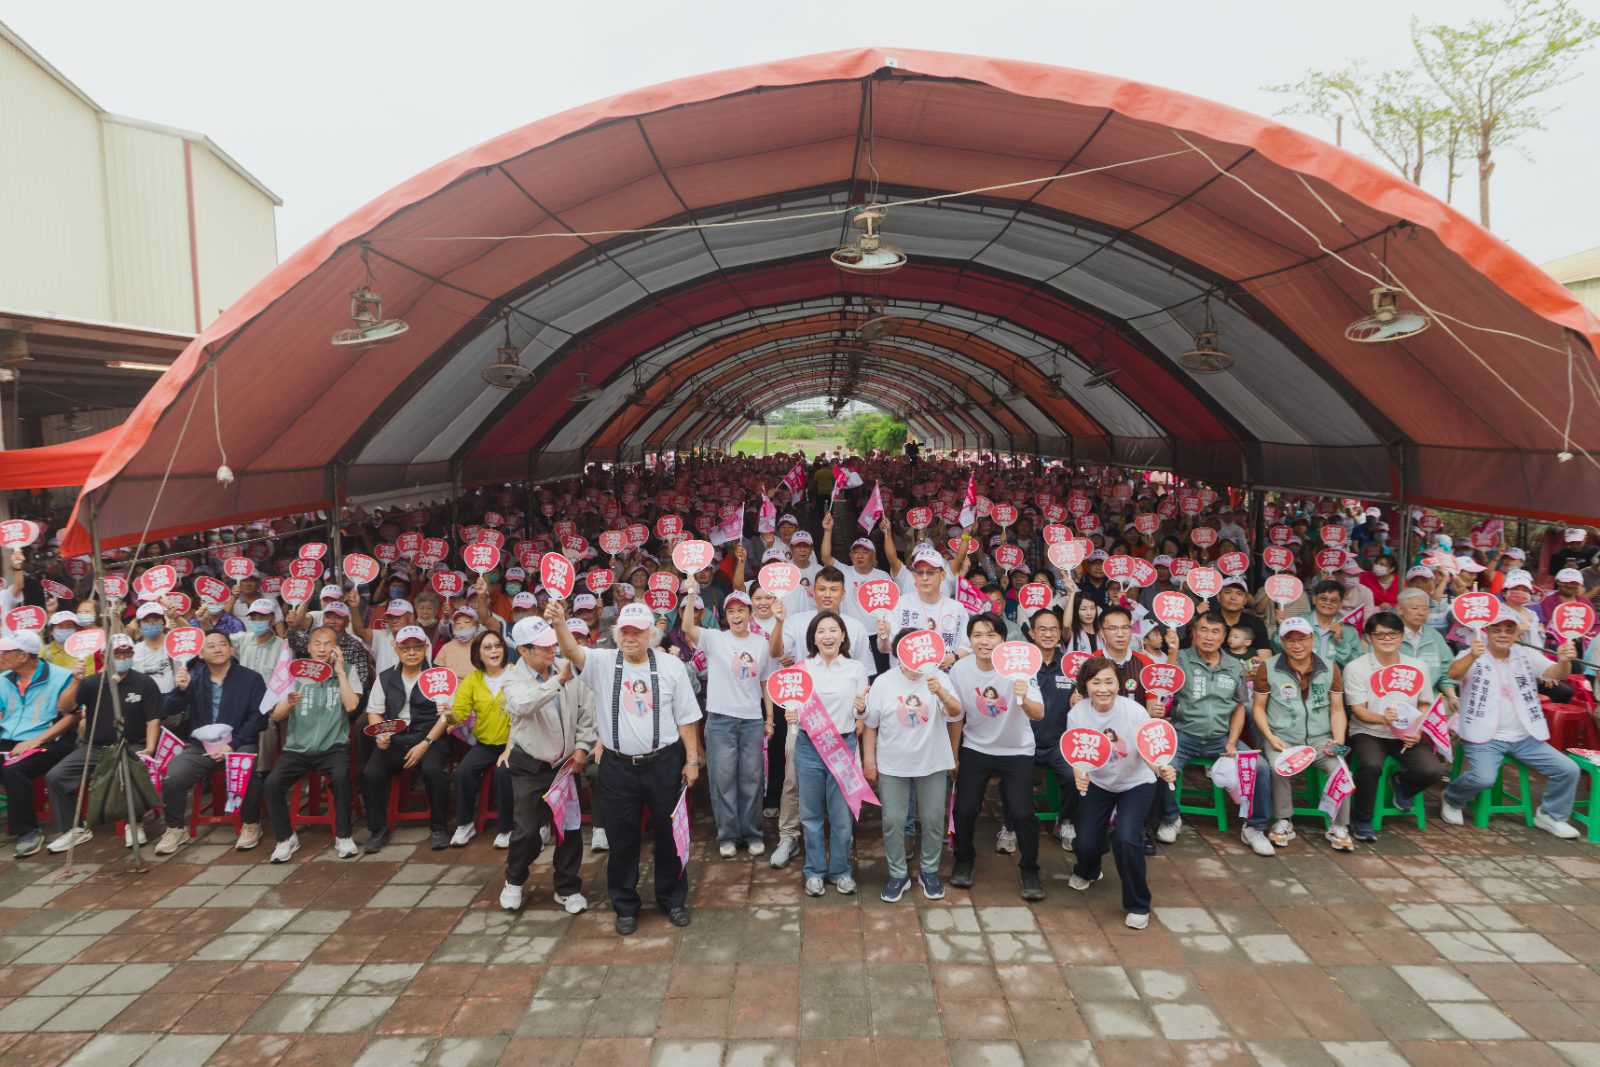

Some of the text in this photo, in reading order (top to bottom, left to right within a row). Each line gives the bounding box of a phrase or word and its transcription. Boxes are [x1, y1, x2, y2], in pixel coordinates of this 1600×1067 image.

[472, 546, 492, 565] 潔
[548, 556, 569, 589] 潔
[866, 583, 891, 607] 潔
[1026, 586, 1045, 605] 潔
[1163, 595, 1185, 618] 潔
[1462, 596, 1490, 619] 潔
[1562, 606, 1586, 629] 潔
[174, 630, 197, 651] 潔
[906, 633, 936, 664] 潔
[1003, 645, 1031, 670] 潔
[426, 671, 449, 693] 潔
[777, 672, 804, 698] 潔
[1150, 666, 1176, 688] 潔
[1072, 731, 1100, 761] 潔
[1142, 725, 1170, 756] 潔
